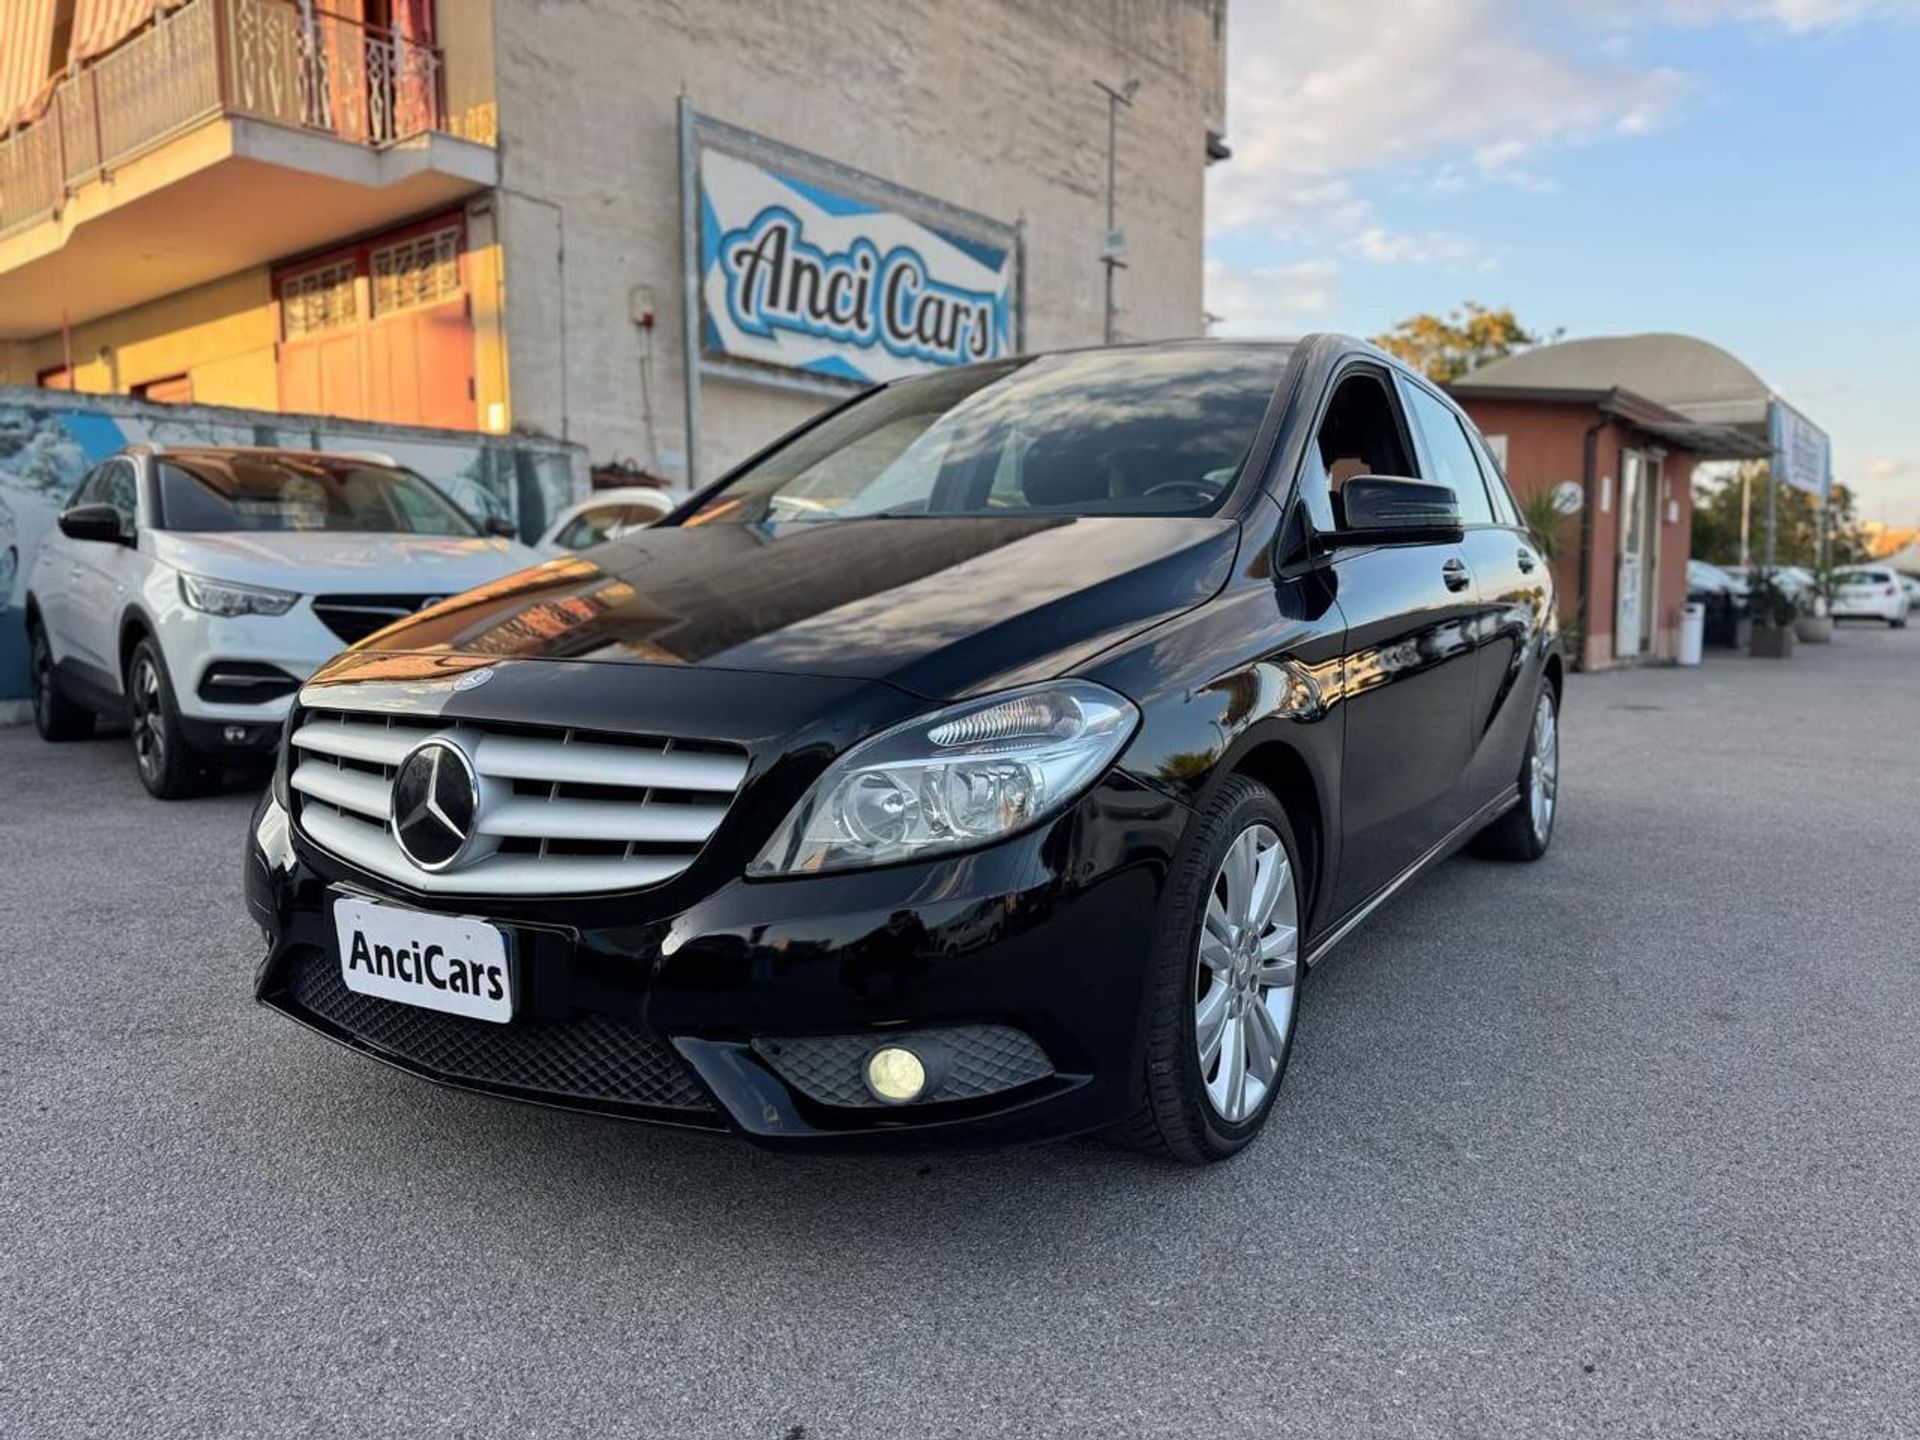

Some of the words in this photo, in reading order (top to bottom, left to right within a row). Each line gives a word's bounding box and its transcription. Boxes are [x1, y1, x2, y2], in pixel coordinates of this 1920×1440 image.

[734, 224, 870, 331] Anci
[886, 263, 988, 356] Cars
[350, 930, 504, 1000] AnciCars
